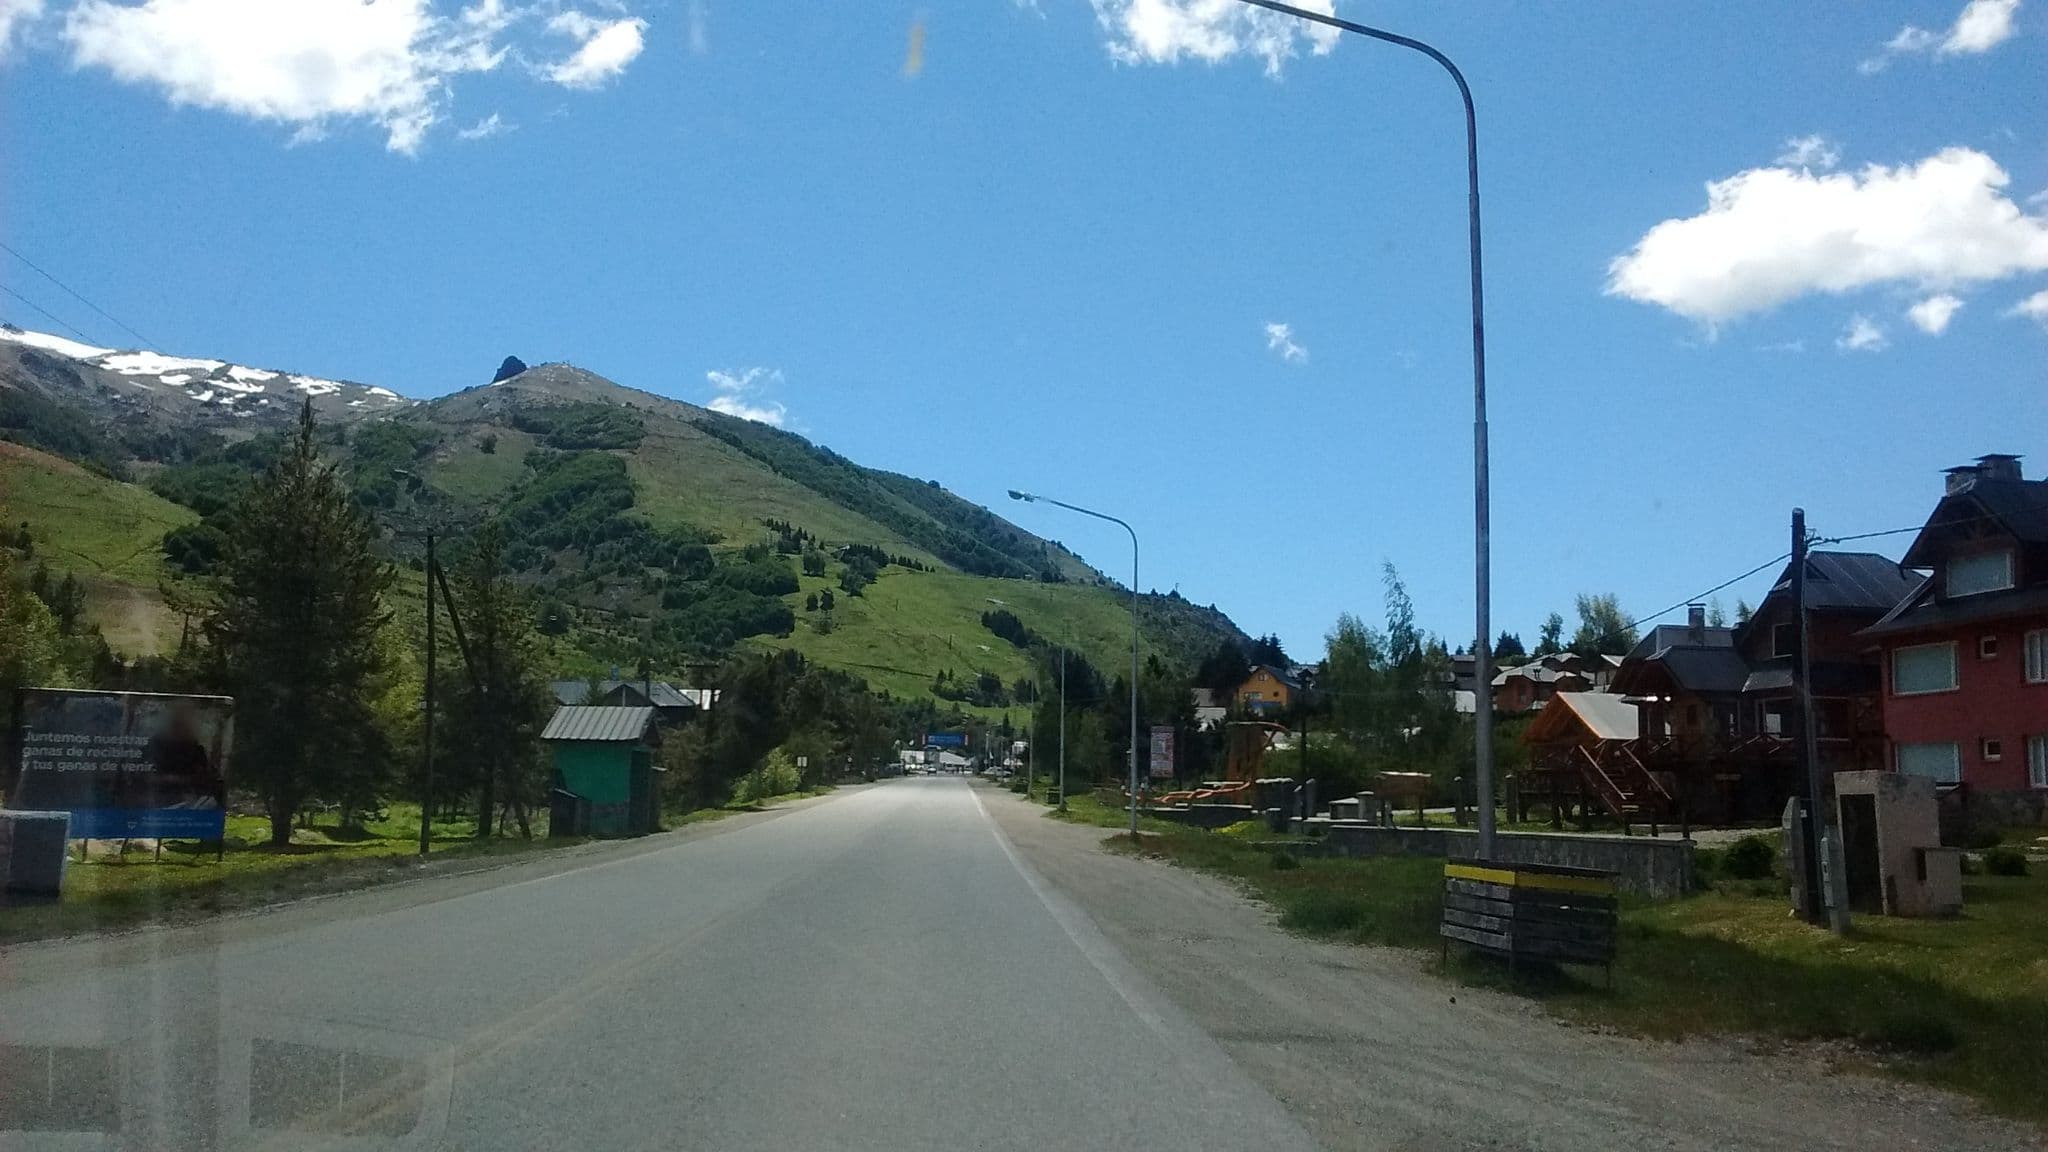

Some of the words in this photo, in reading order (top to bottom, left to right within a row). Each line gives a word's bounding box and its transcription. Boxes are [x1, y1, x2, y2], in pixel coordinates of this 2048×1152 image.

[23, 732, 91, 744] Juntemos
[22, 747, 63, 758] ganas
[66, 746, 84, 757] de
[21, 760, 30, 772] y
[33, 760, 53, 770] tus
[57, 761, 98, 772] ganas
[102, 761, 118, 771] de
